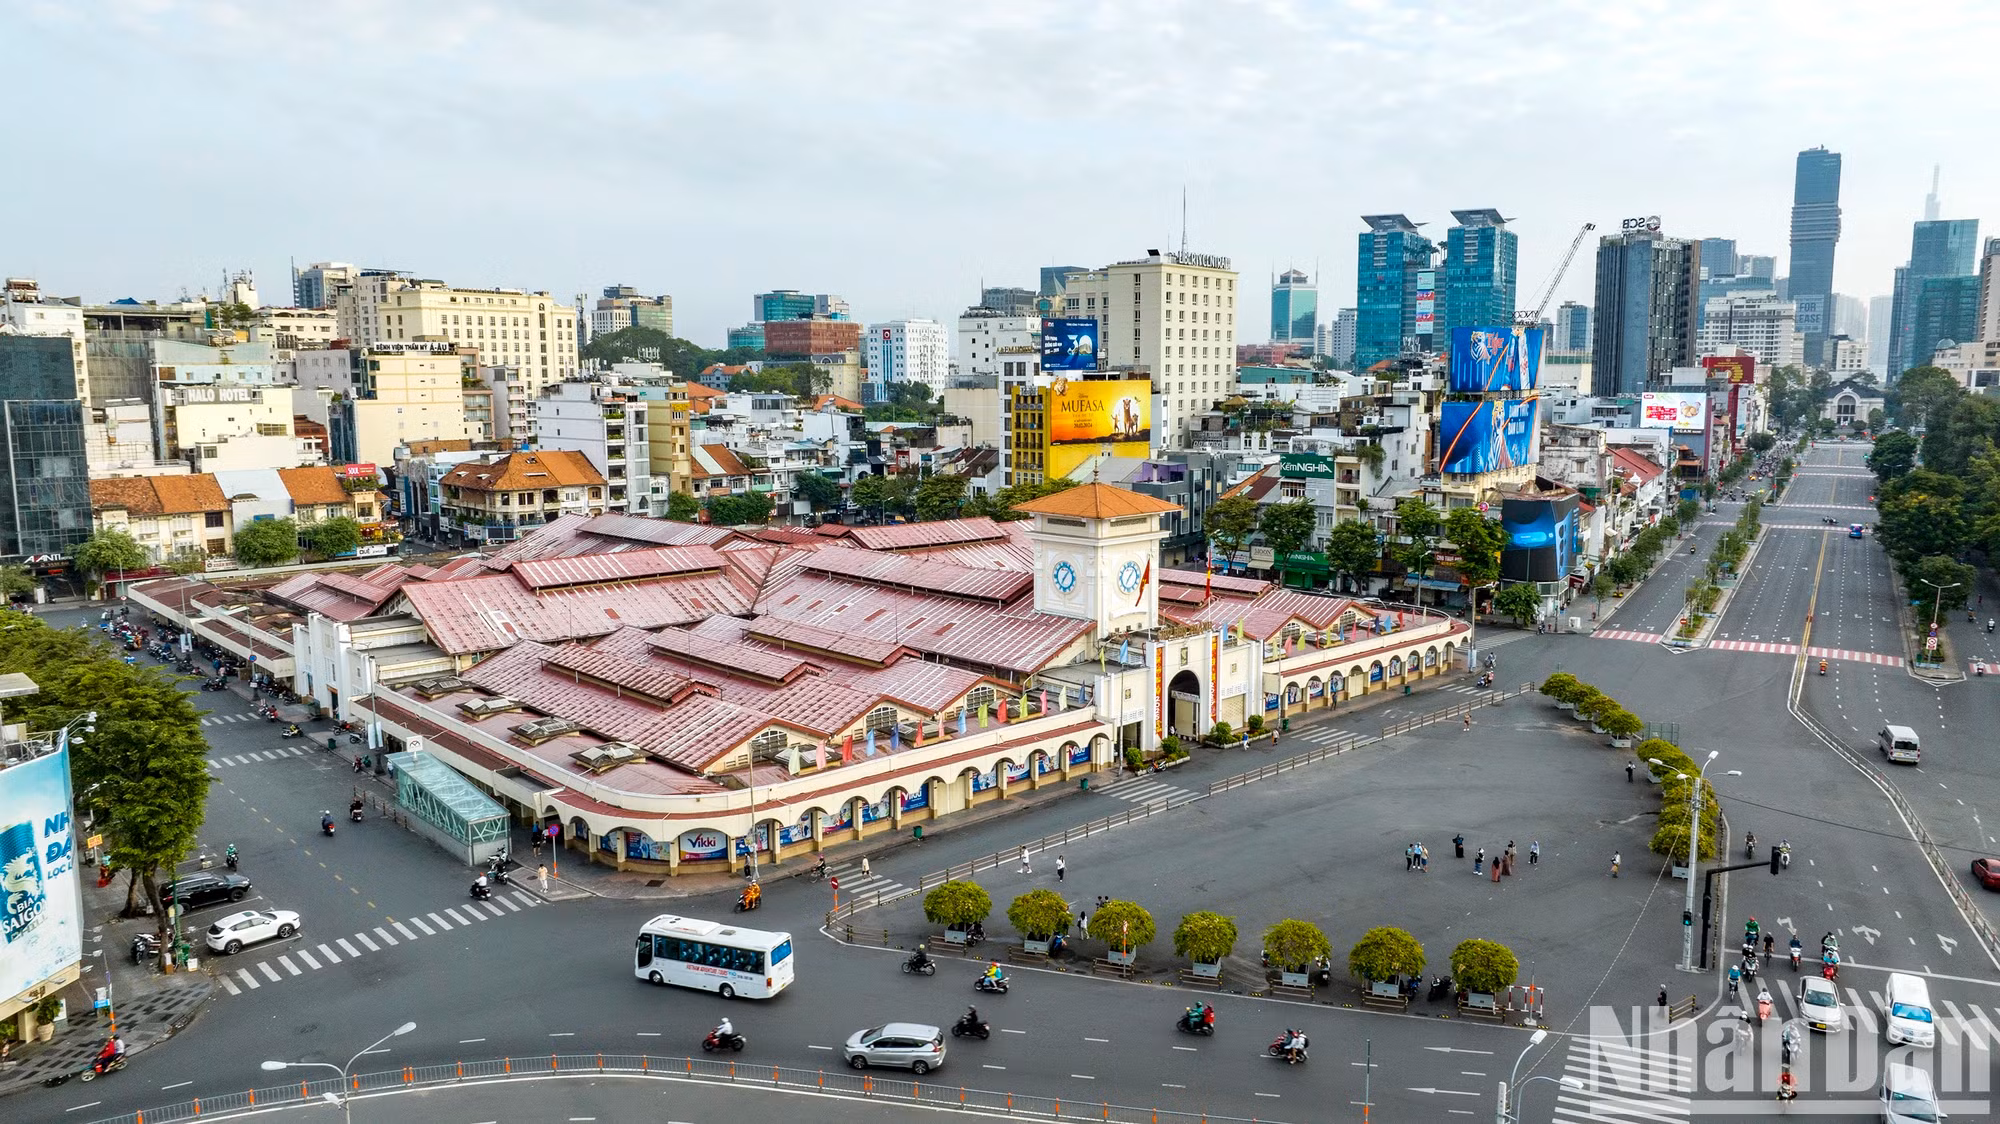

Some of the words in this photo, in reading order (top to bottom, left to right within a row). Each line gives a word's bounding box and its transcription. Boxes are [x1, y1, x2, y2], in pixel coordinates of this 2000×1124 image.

[1800, 303, 1817, 312] FOR
[188, 388, 215, 402] HALO
[219, 388, 250, 402] HOTEL
[1061, 399, 1105, 413] MUFASA
[687, 833, 716, 849] Vikki
[17, 899, 33, 912] BIA
